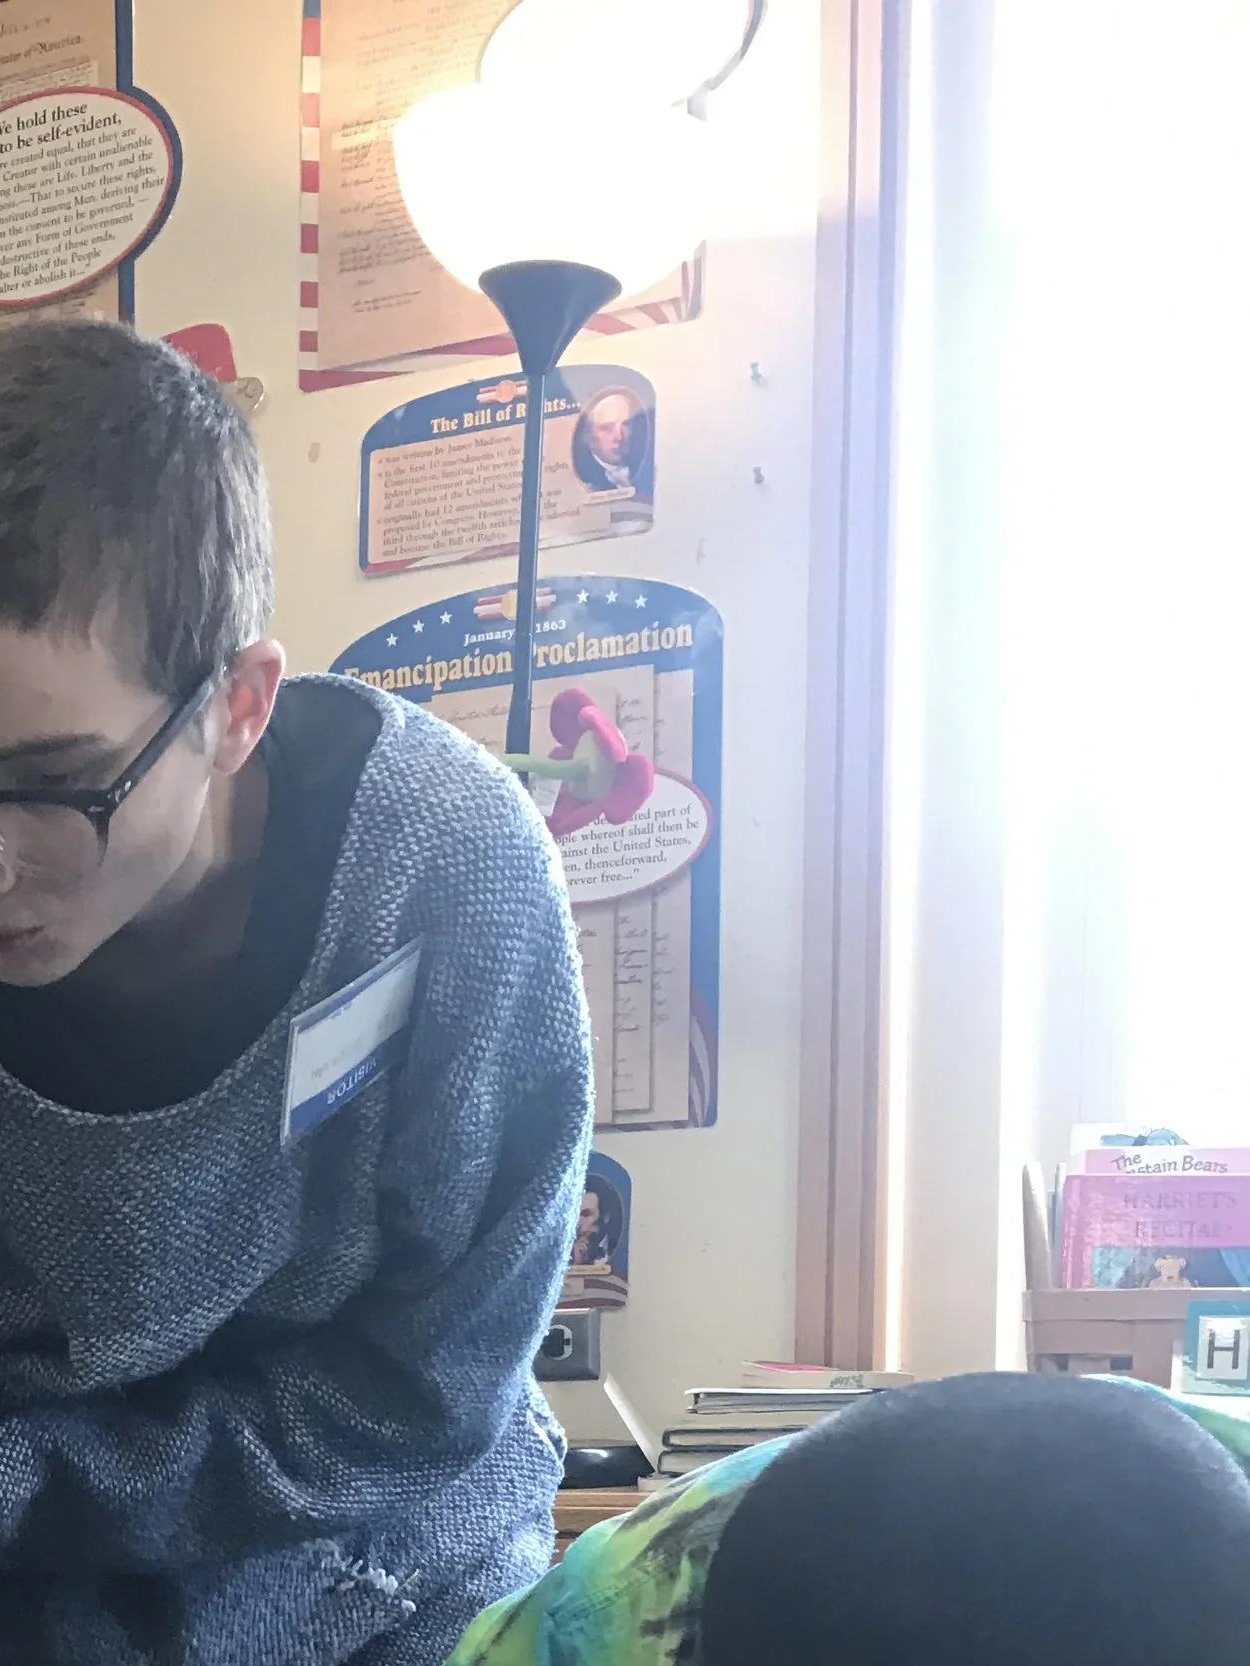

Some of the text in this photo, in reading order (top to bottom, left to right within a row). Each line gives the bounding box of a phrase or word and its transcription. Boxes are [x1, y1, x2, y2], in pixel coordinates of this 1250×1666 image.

[17, 109, 47, 131] hold
[52, 103, 87, 120] these
[0, 142, 12, 153] to
[17, 135, 33, 149] be
[37, 112, 122, 143] self-evident,
[77, 139, 95, 152] that
[120, 128, 136, 137] are
[17, 239, 32, 249] any
[35, 232, 60, 244] Form
[63, 227, 72, 237] of
[75, 214, 133, 235] Government
[0, 250, 49, 266] destructive
[53, 244, 62, 254] of
[65, 239, 88, 249] these
[14, 263, 38, 277] Right
[41, 259, 51, 269] of
[54, 255, 67, 266] the
[71, 248, 101, 264] People
[431, 417, 458, 434] The
[463, 410, 491, 428] Bill
[496, 406, 512, 422] of
[464, 619, 567, 647] January 1863
[344, 621, 694, 691] Emancipation roclamation
[654, 807, 675, 820] part
[680, 803, 691, 815] of
[581, 826, 626, 841] whereof
[628, 821, 654, 836] shall
[658, 819, 682, 833] then
[686, 817, 698, 829] be
[561, 836, 691, 858] ainst the United States,
[564, 850, 667, 871] en, thenceforward,
[326, 1058, 378, 1105] VISITOR
[1111, 1152, 1143, 1172] The
[1181, 1154, 1229, 1174] Bears
[1124, 1190, 1237, 1210] HARRIET'S
[1134, 1220, 1222, 1239] RECITAL
[1207, 1329, 1241, 1370] H
